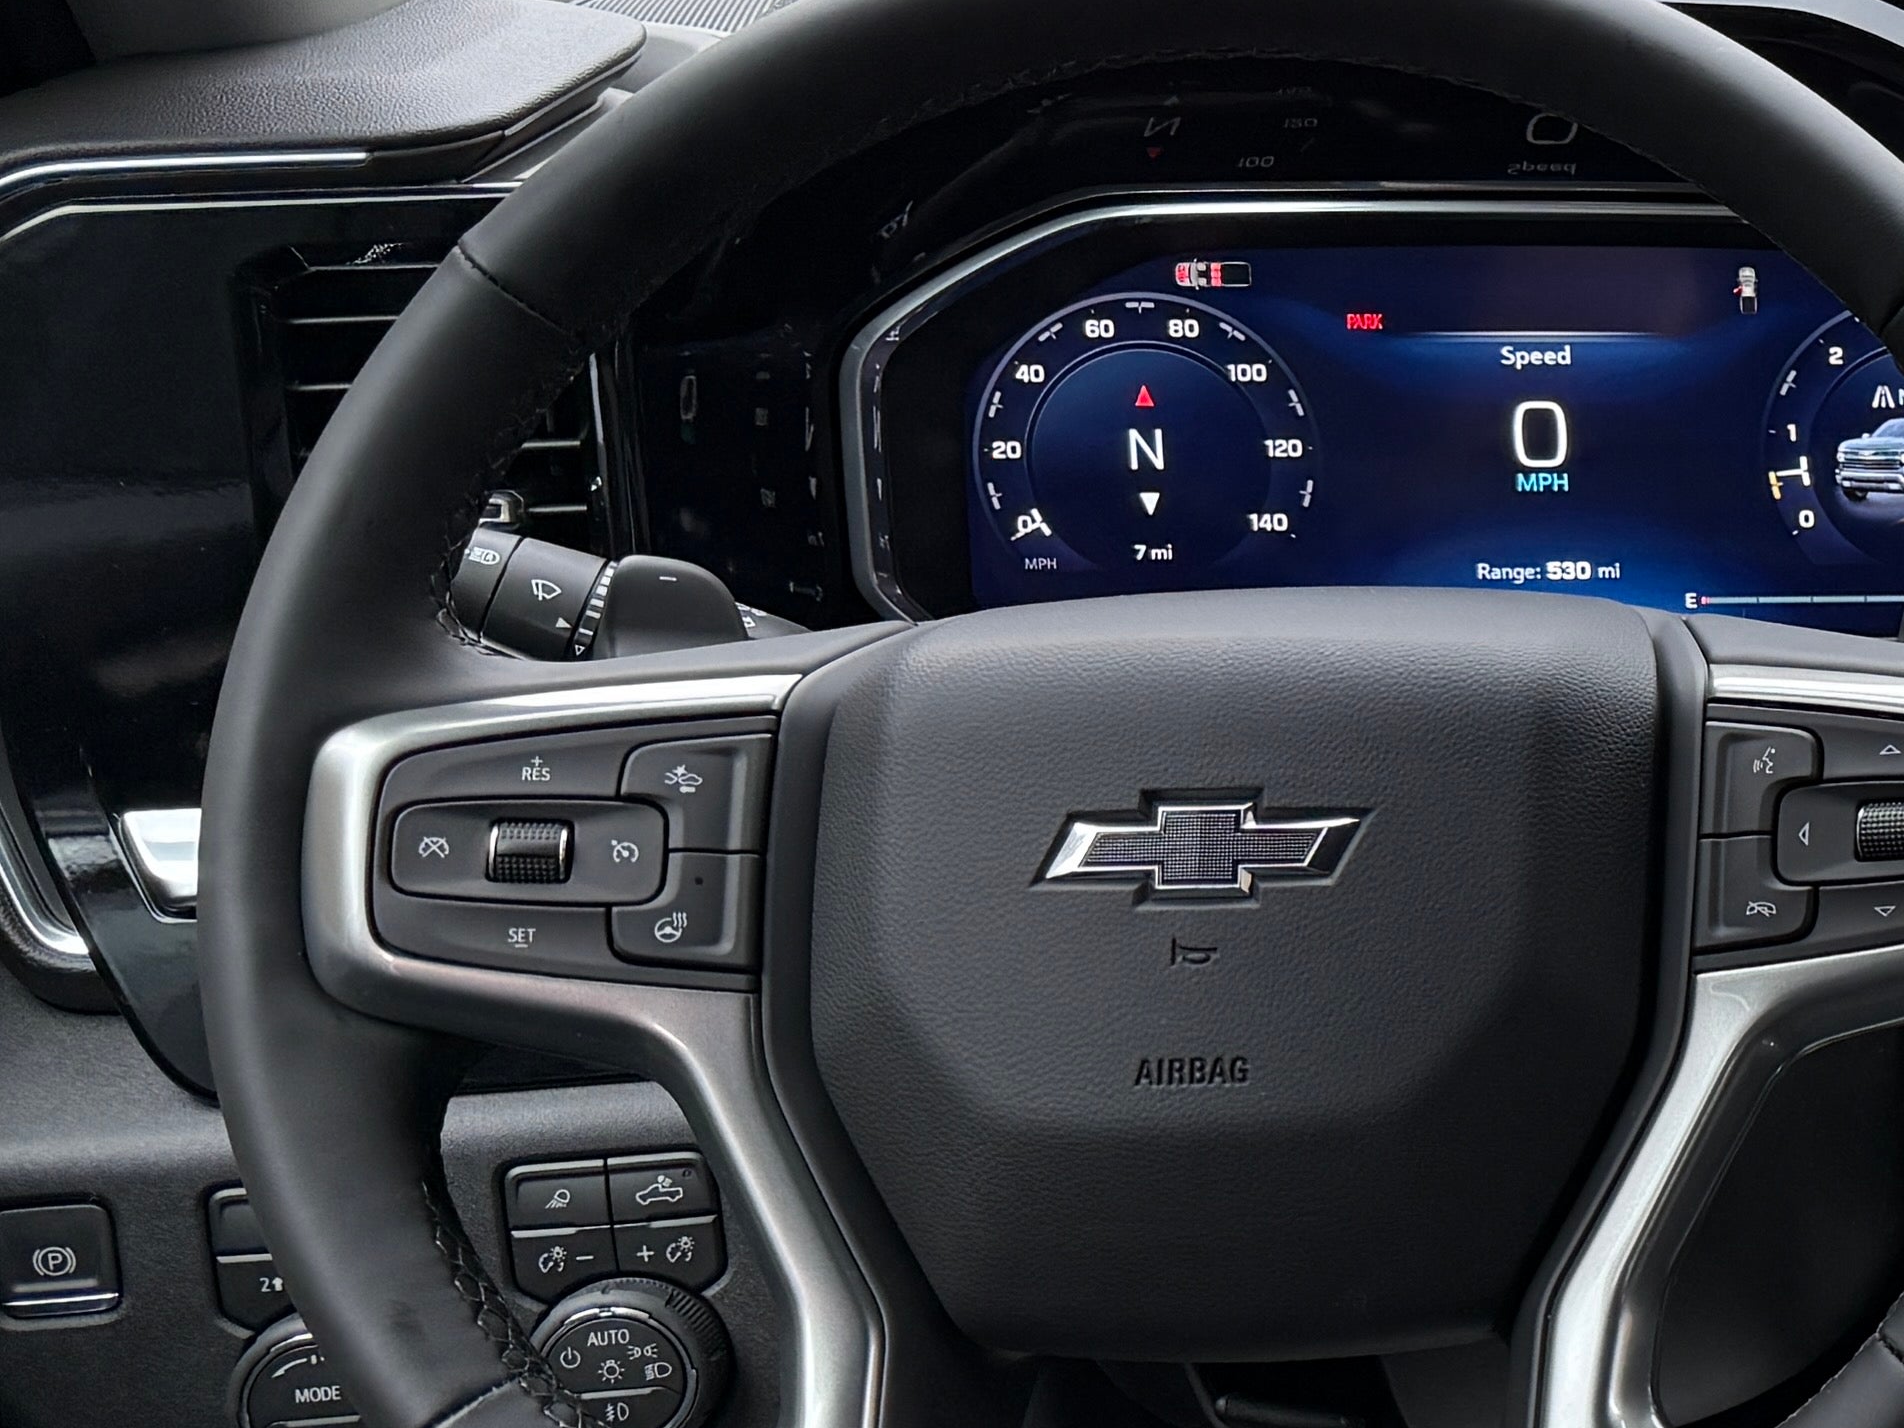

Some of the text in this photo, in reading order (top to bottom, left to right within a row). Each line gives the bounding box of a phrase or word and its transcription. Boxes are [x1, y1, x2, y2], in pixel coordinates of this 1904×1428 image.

[1085, 319, 1115, 338] 60
[1168, 319, 1199, 338] 80
[1346, 313, 1384, 330] PARK
[1500, 345, 1572, 370] Speed
[1828, 346, 1844, 365] 2
[1015, 364, 1045, 383] 40
[1227, 363, 1268, 382] 100
[1512, 400, 1568, 468] 0
[1787, 424, 1797, 442] 1
[992, 441, 1022, 460] 20
[1128, 427, 1165, 471] N
[1264, 439, 1303, 458] 120
[1515, 473, 1569, 492] MPH
[1248, 512, 1288, 532] 140
[1799, 509, 1815, 528] 0
[1134, 544, 1173, 561] 7 mi
[1024, 556, 1058, 570] MPH
[1475, 560, 1621, 585] Range: 530 mi
[1685, 592, 1698, 609] E
[521, 766, 551, 782] RES
[507, 927, 537, 944] SET
[1133, 1055, 1251, 1089] AIRBAG
[587, 1328, 630, 1347] AUTO
[295, 1385, 342, 1403] MODE
